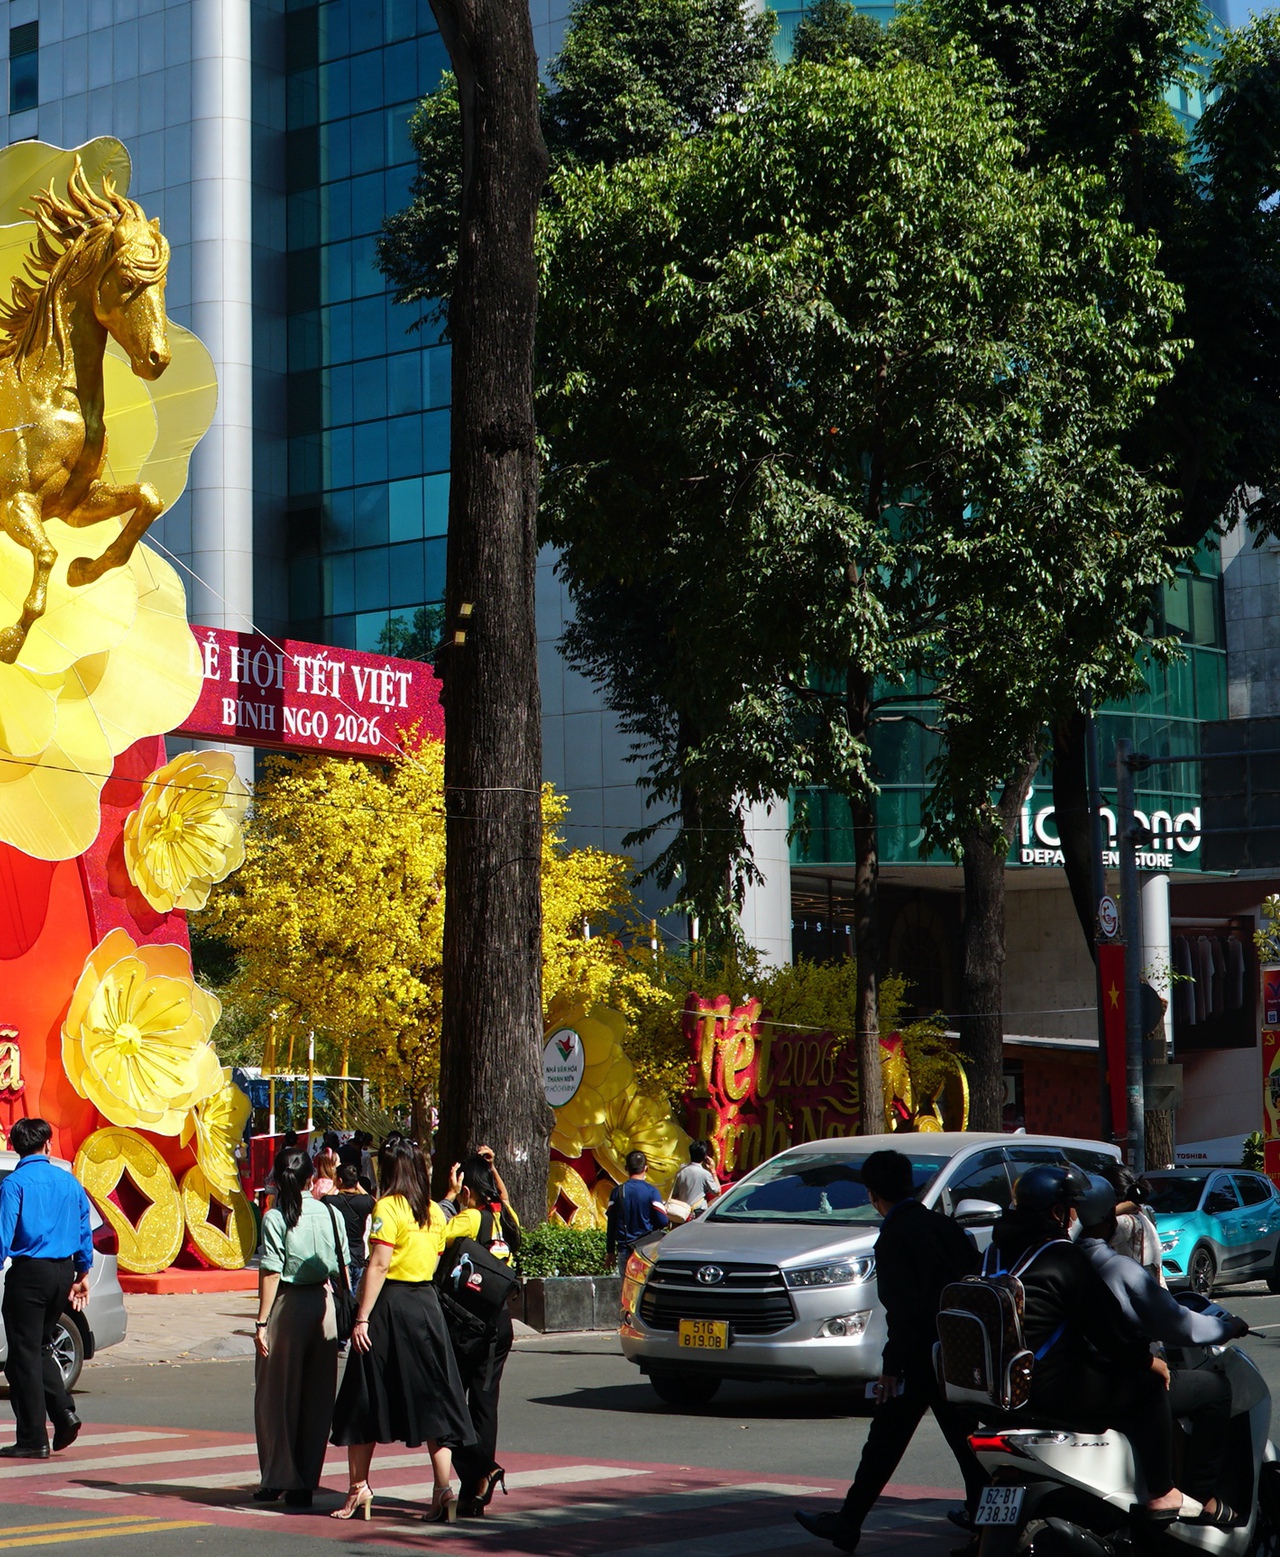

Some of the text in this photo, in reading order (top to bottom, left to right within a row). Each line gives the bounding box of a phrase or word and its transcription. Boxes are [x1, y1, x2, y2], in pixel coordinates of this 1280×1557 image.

[229, 645, 285, 695] HỘI
[293, 651, 345, 698] TẾT
[351, 664, 412, 713] VIỆT
[222, 695, 381, 745] BÍNH NGỌ 2026
[1022, 848, 1120, 865] DEPAEN
[691, 1003, 835, 1101] Tết 2026
[515, 1150, 528, 1162] 24
[693, 1322, 714, 1334] 51G
[684, 1335, 722, 1347] 819.08
[986, 1487, 1017, 1504] 62-B1
[977, 1506, 1018, 1523] 738.38
